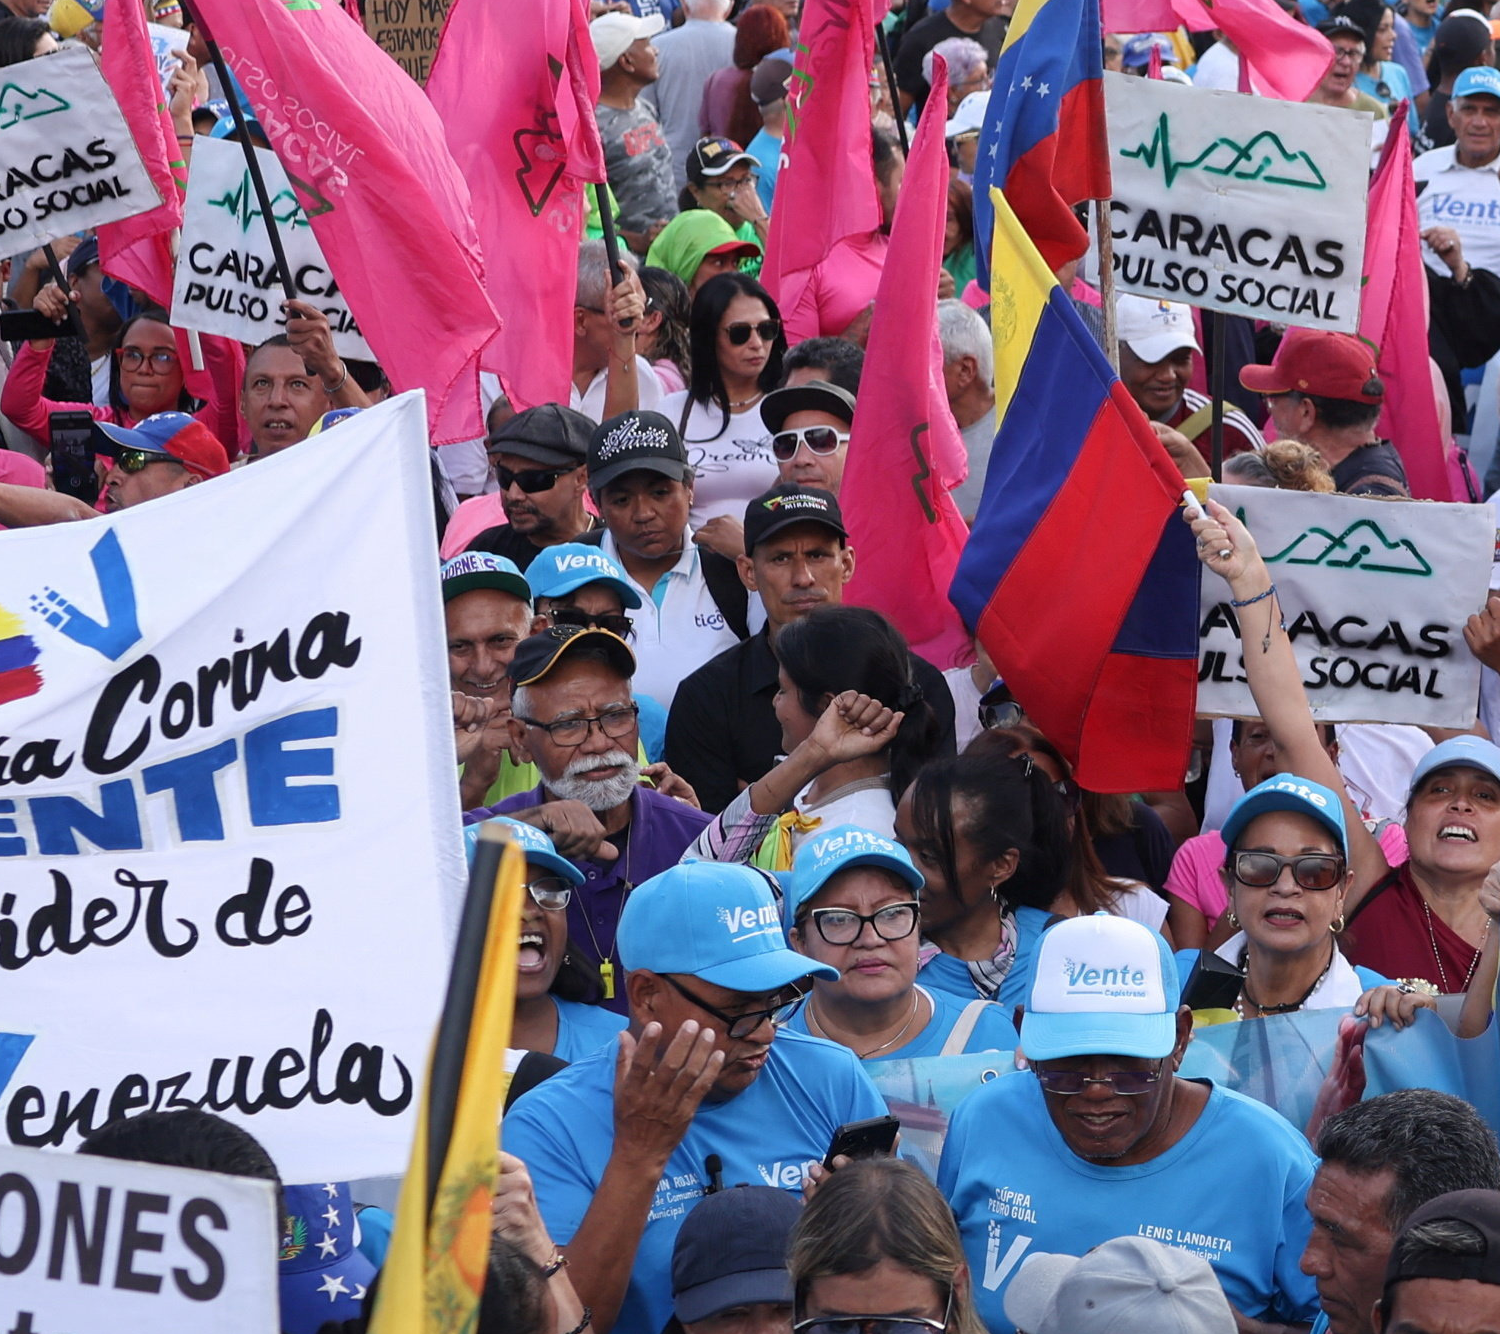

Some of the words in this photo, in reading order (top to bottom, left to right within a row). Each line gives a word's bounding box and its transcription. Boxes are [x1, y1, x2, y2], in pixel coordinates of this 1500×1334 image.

[33, 152, 132, 212] SOCIAL
[1106, 200, 1345, 281] CARACAS
[183, 282, 269, 323] PULSO
[1110, 250, 1208, 300] PULSO
[1214, 272, 1340, 322] SOCIAL
[555, 552, 621, 580] Vente
[82, 608, 362, 785] Corina
[1303, 654, 1445, 701] SOCIAL
[813, 829, 895, 859] Vente
[224, 856, 313, 948] de
[1063, 957, 1146, 987] Vente
[758, 1158, 820, 1189] Ven
[1011, 1203, 1038, 1225] GUAL
[1137, 1223, 1174, 1242] LENIS
[1176, 1229, 1233, 1254] LANDAETA
